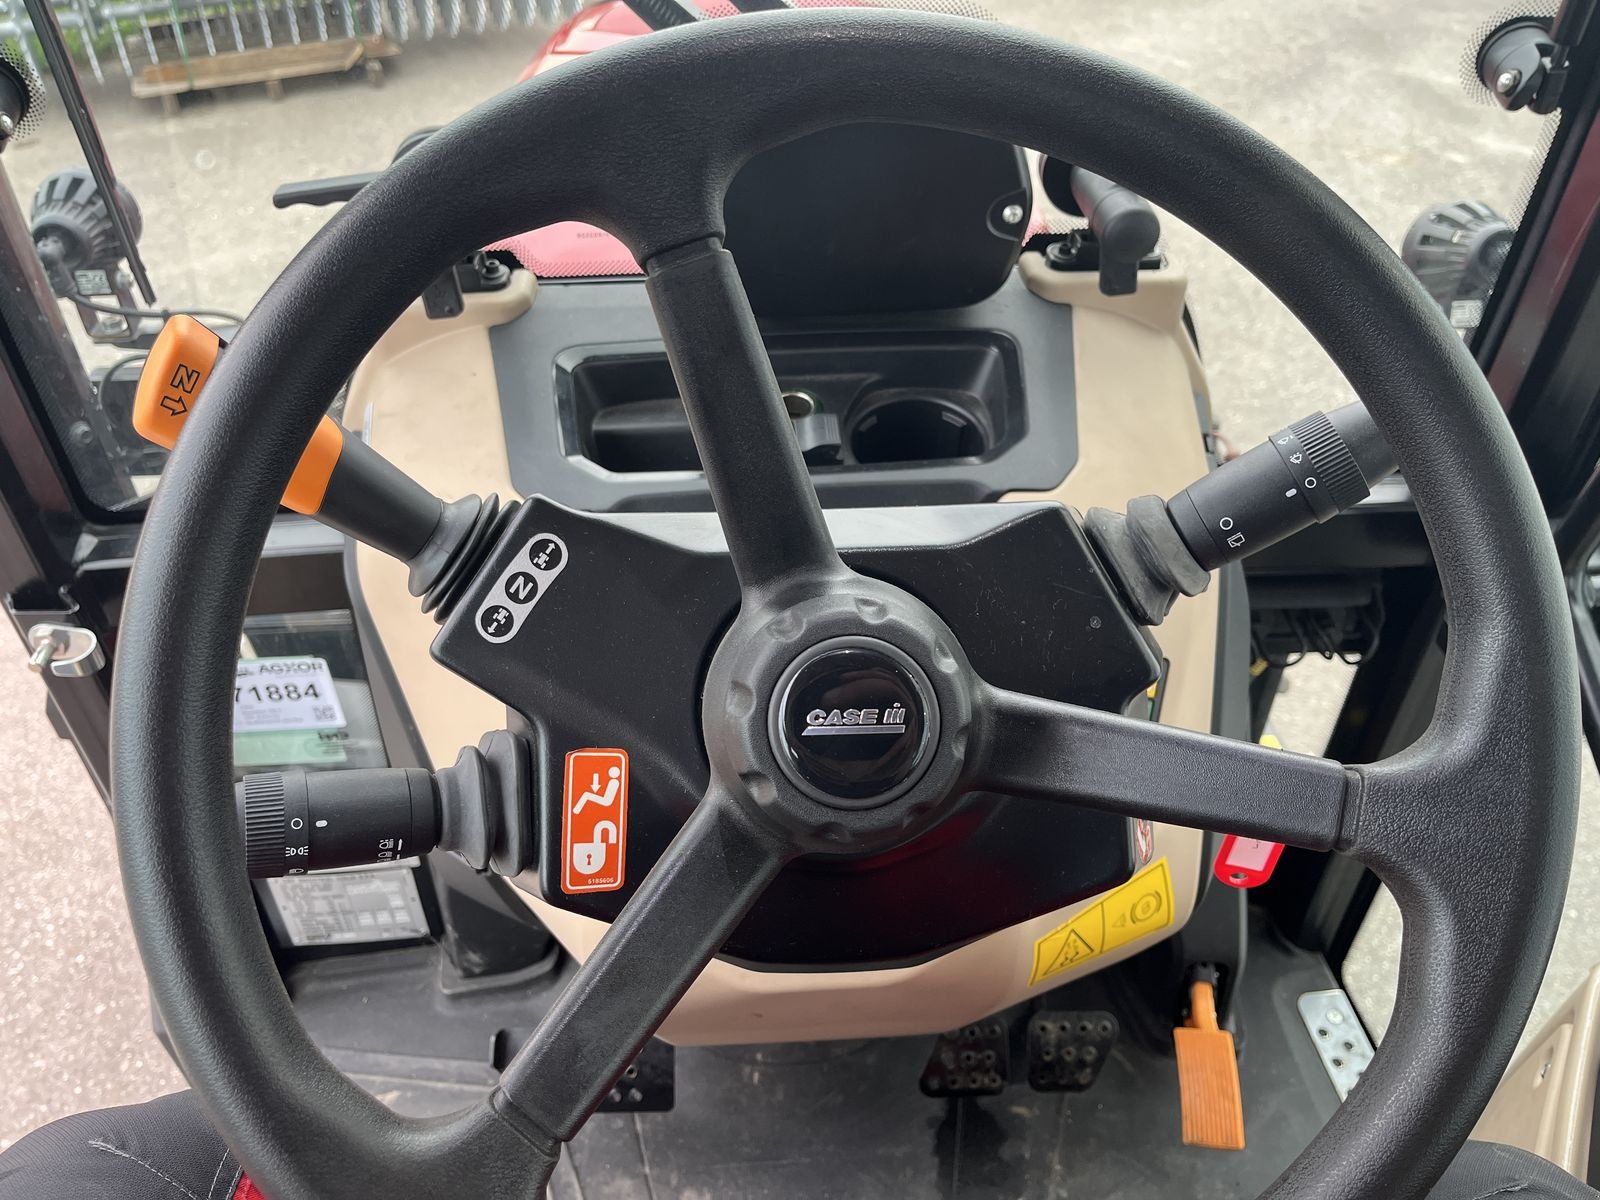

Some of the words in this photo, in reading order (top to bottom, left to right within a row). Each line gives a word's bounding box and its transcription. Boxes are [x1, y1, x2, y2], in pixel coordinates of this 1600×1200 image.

[170, 363, 200, 394] N
[509, 575, 534, 600] N
[806, 708, 880, 726] CASE
